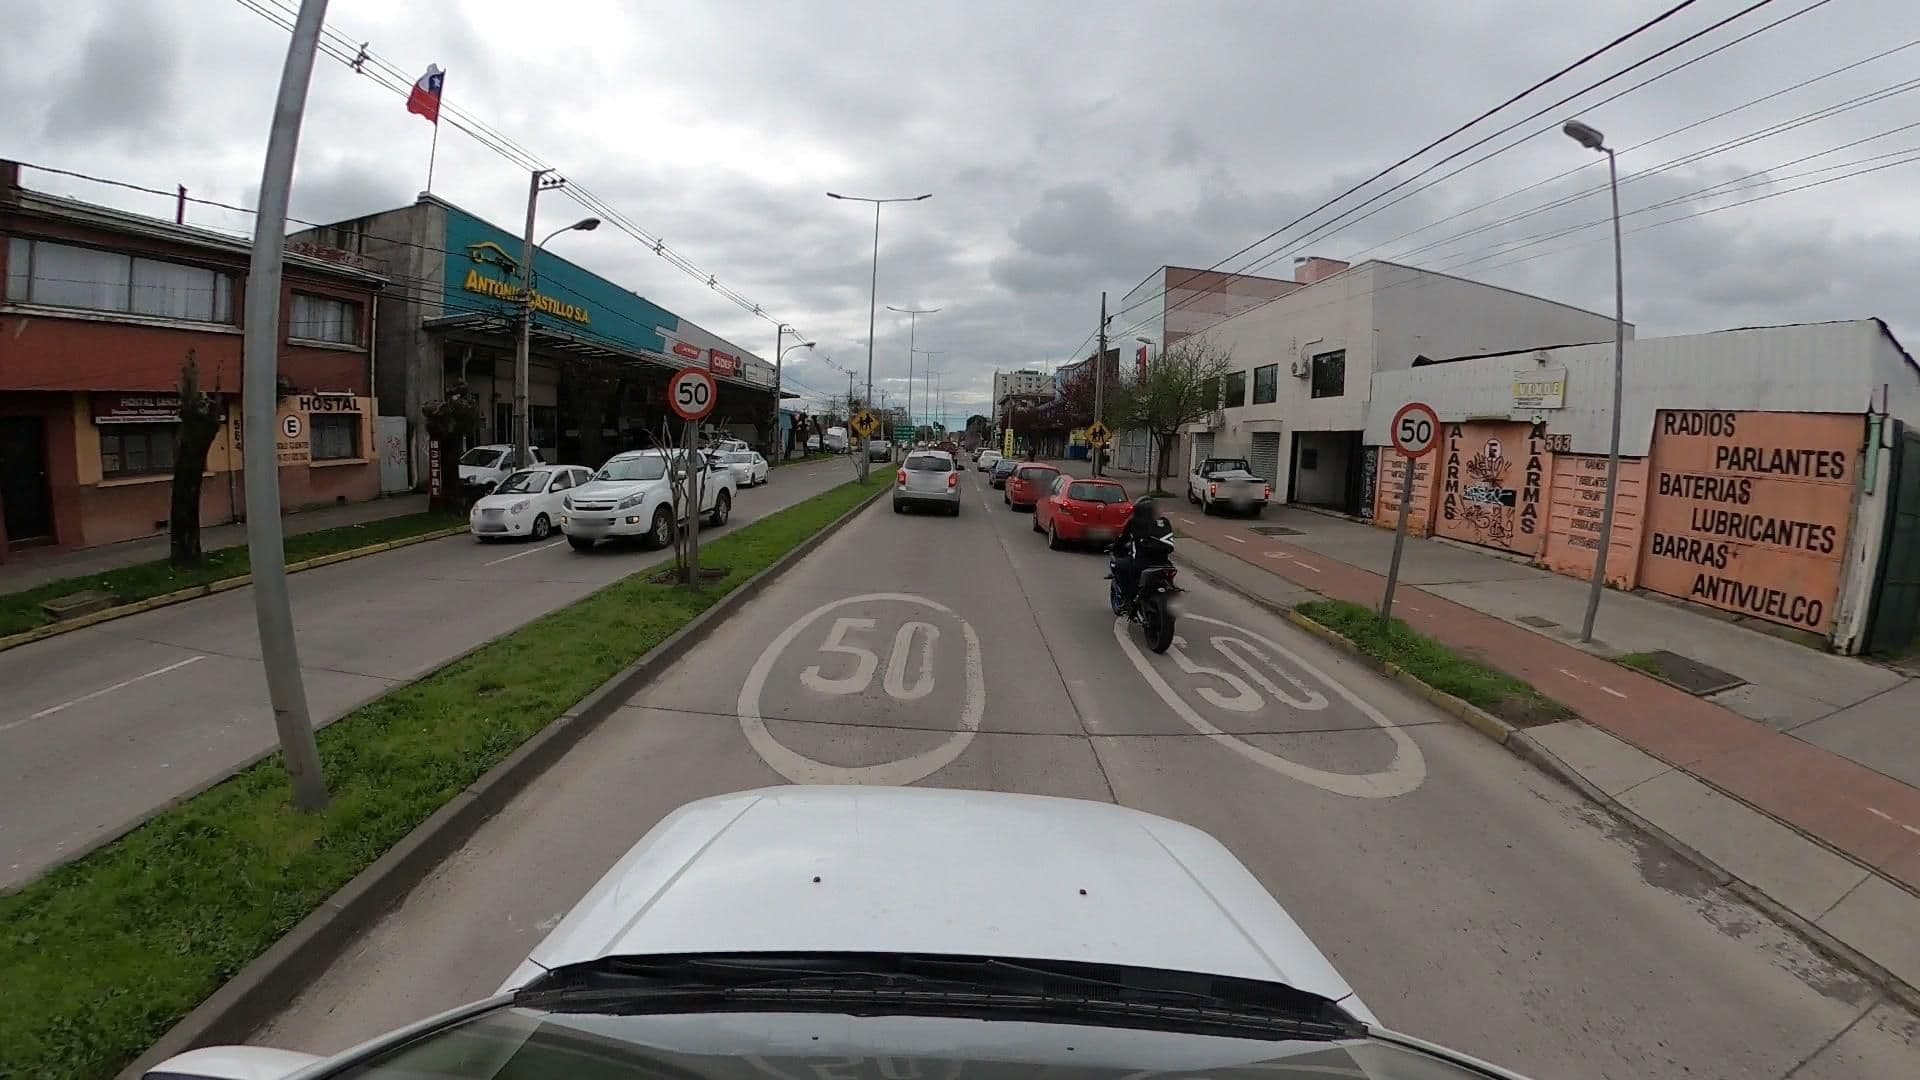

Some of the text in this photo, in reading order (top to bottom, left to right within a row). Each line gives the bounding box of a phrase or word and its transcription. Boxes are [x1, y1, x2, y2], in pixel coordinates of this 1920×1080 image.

[528, 287, 573, 319] CASTILLO
[300, 397, 361, 411] HOSTAL
[679, 382, 708, 405] 50
[287, 420, 297, 433] E
[1400, 419, 1431, 443] 50
[1664, 412, 1737, 438] RADIOS
[1715, 446, 1845, 479] PARLANTES
[1659, 472, 1751, 505] BATERIAS
[1691, 507, 1836, 554] LUBRICANTES
[1652, 533, 1729, 569] BARRAS
[1692, 573, 1823, 627] ANTIVUELCO
[799, 617, 940, 700] 50
[1165, 635, 1329, 711] 50
